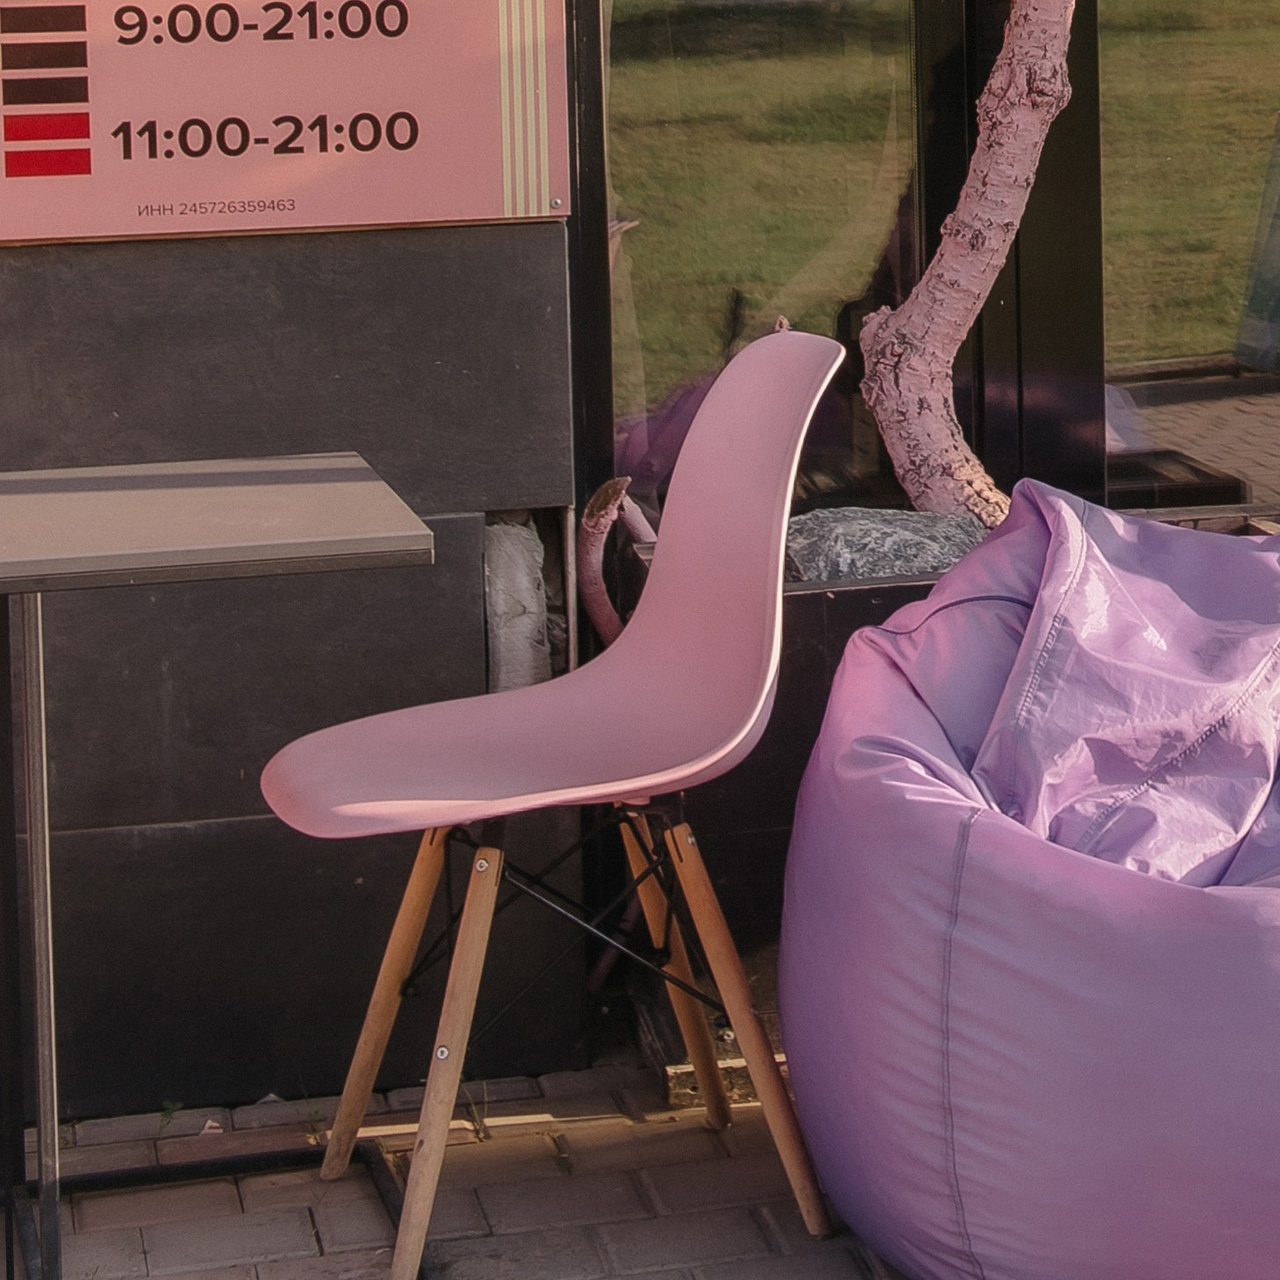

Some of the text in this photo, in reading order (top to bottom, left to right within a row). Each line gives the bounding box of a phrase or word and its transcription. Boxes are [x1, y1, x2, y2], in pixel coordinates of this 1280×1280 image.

[110, 111, 419, 160] 11:00-21:00
[137, 198, 297, 218] ИНН 245726359463
